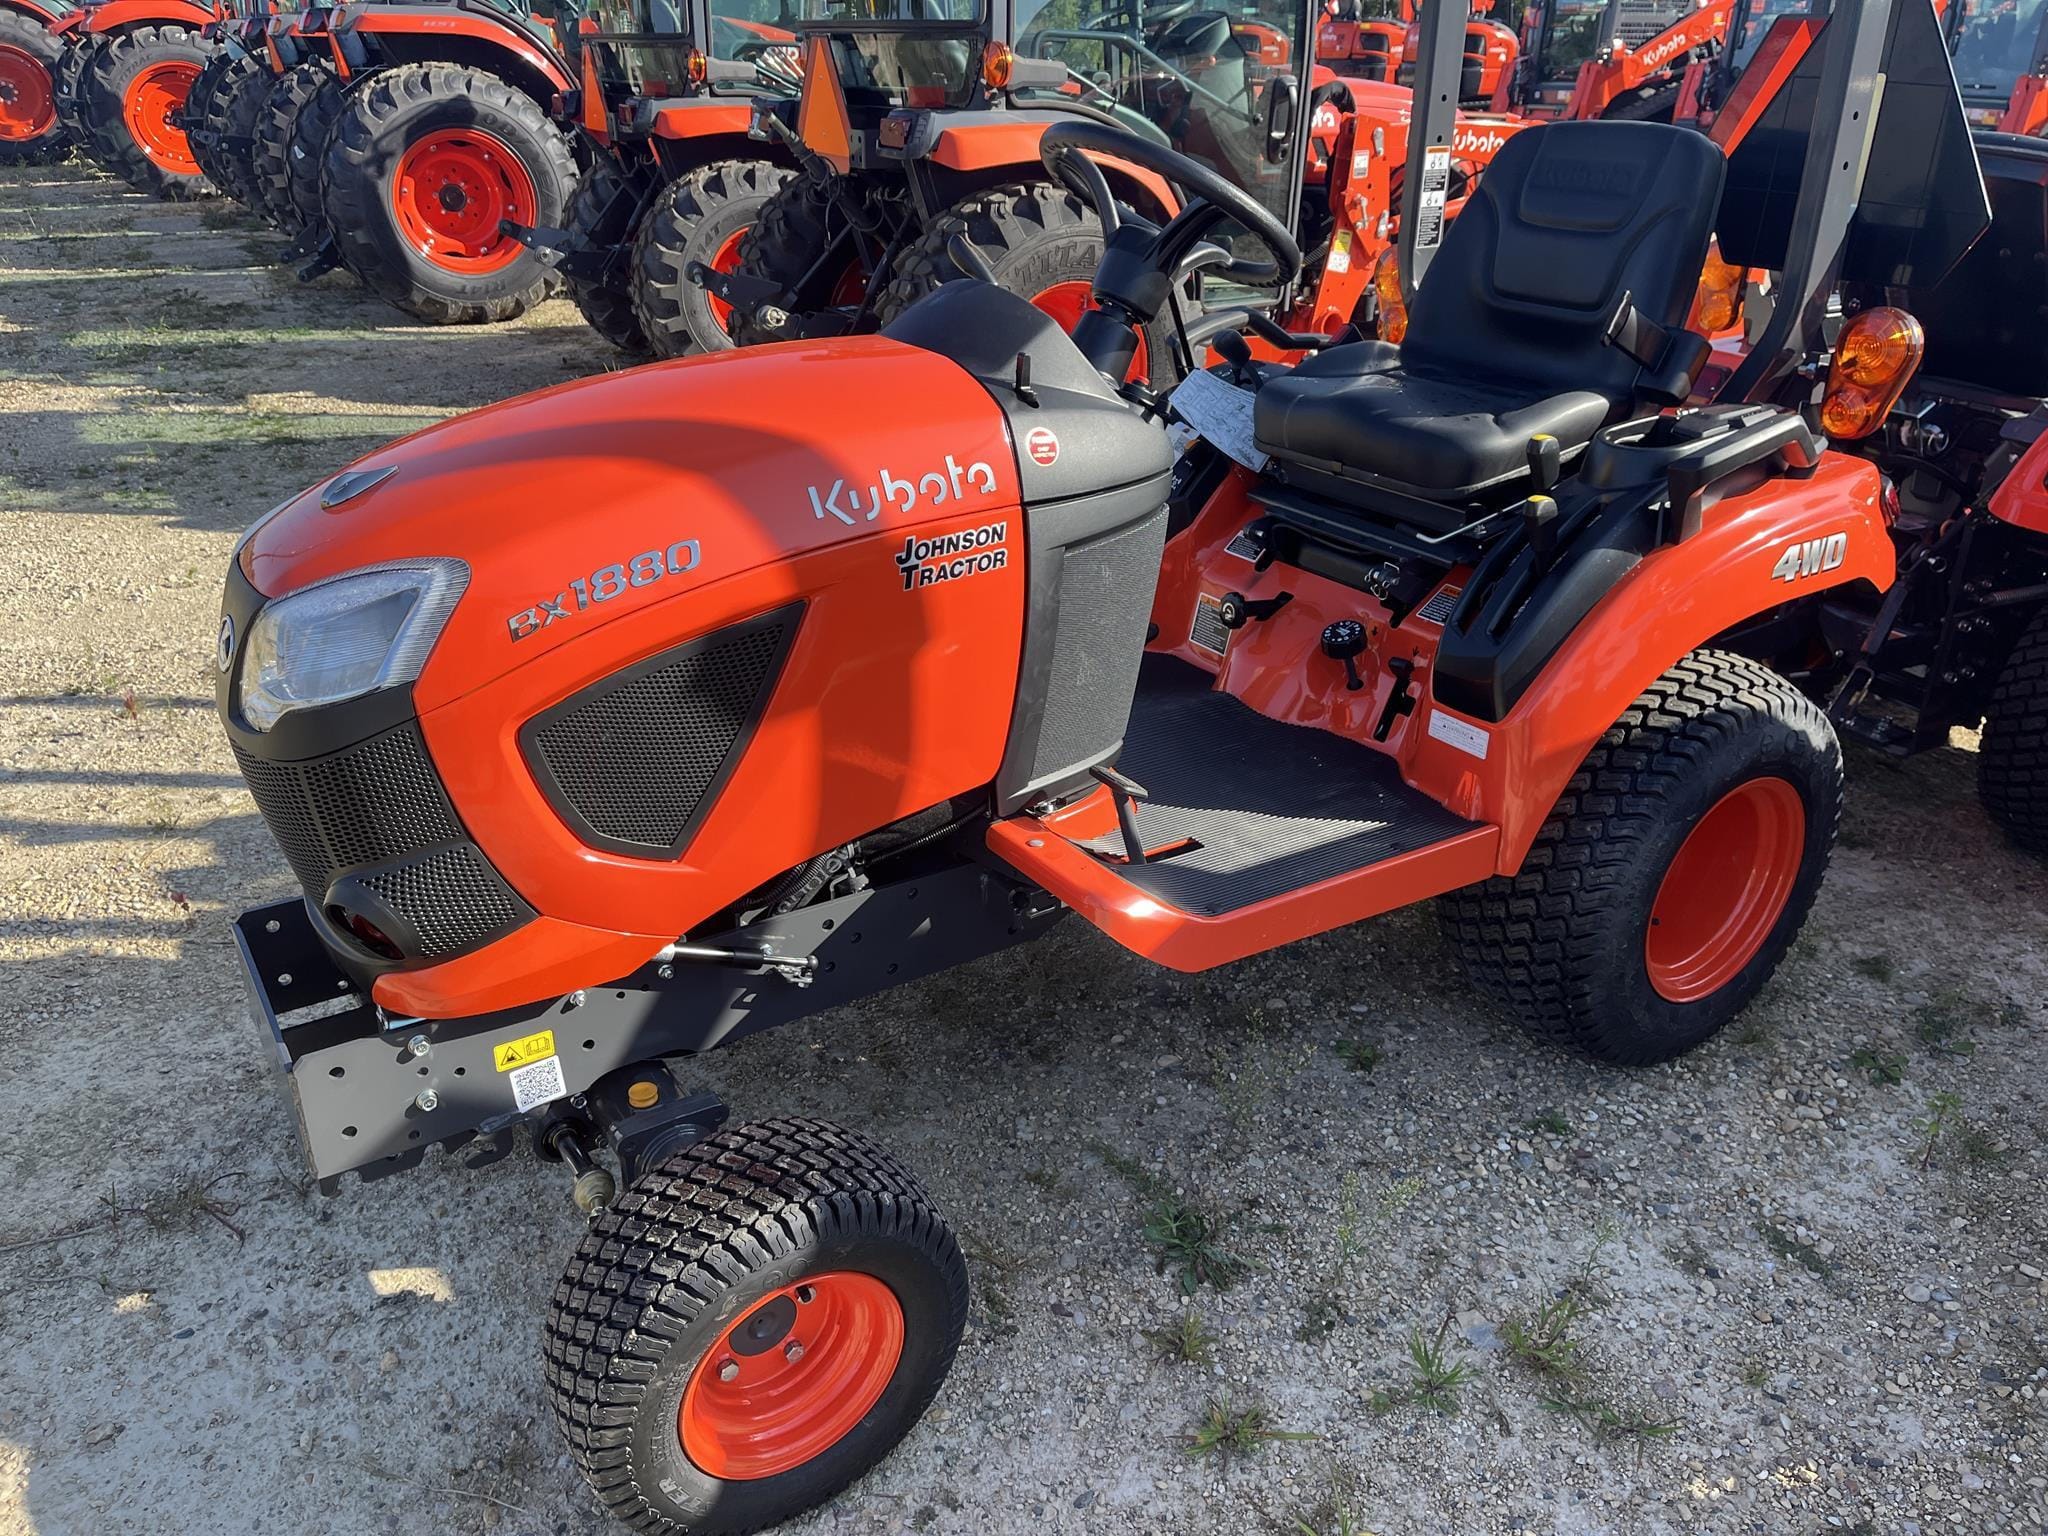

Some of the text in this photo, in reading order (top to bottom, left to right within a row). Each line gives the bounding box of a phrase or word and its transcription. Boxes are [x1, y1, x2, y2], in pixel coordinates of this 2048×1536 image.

[1643, 33, 1686, 66] Kubota
[807, 454, 998, 526] Kubota
[895, 521, 1007, 566] JOHNSON
[1770, 530, 1848, 584] 4WD
[506, 538, 702, 644] BX1880
[900, 549, 1008, 591] TRACTOR
